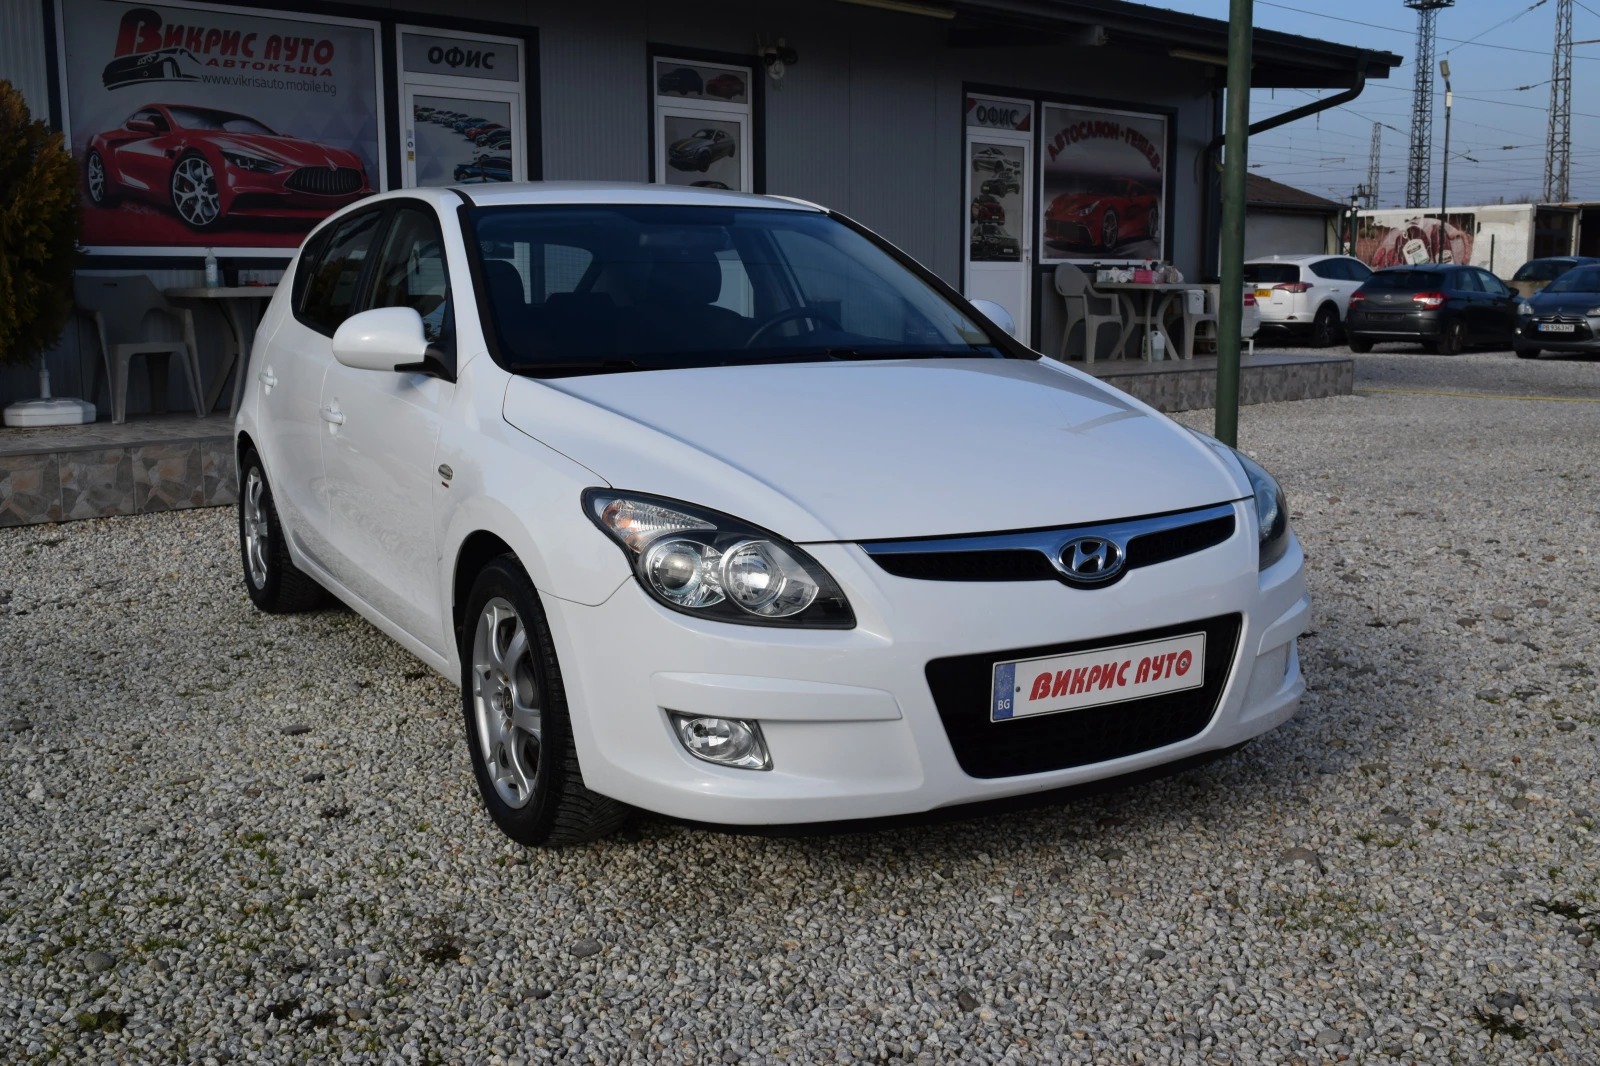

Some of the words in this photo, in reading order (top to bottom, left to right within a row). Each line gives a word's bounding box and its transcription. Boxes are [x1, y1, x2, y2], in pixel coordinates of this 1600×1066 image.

[114, 8, 258, 60] ВИКРИС
[264, 34, 335, 65] АУТО
[205, 58, 333, 77] АВТОКЪЩА
[427, 46, 496, 70] ОФИС
[202, 74, 338, 97] www.vikrisauto.mobile.bg
[976, 105, 1019, 126] ОФИС
[1028, 659, 1132, 702] ВИКРИС
[1134, 649, 1193, 684] АУТО
[997, 699, 1011, 711] BG
